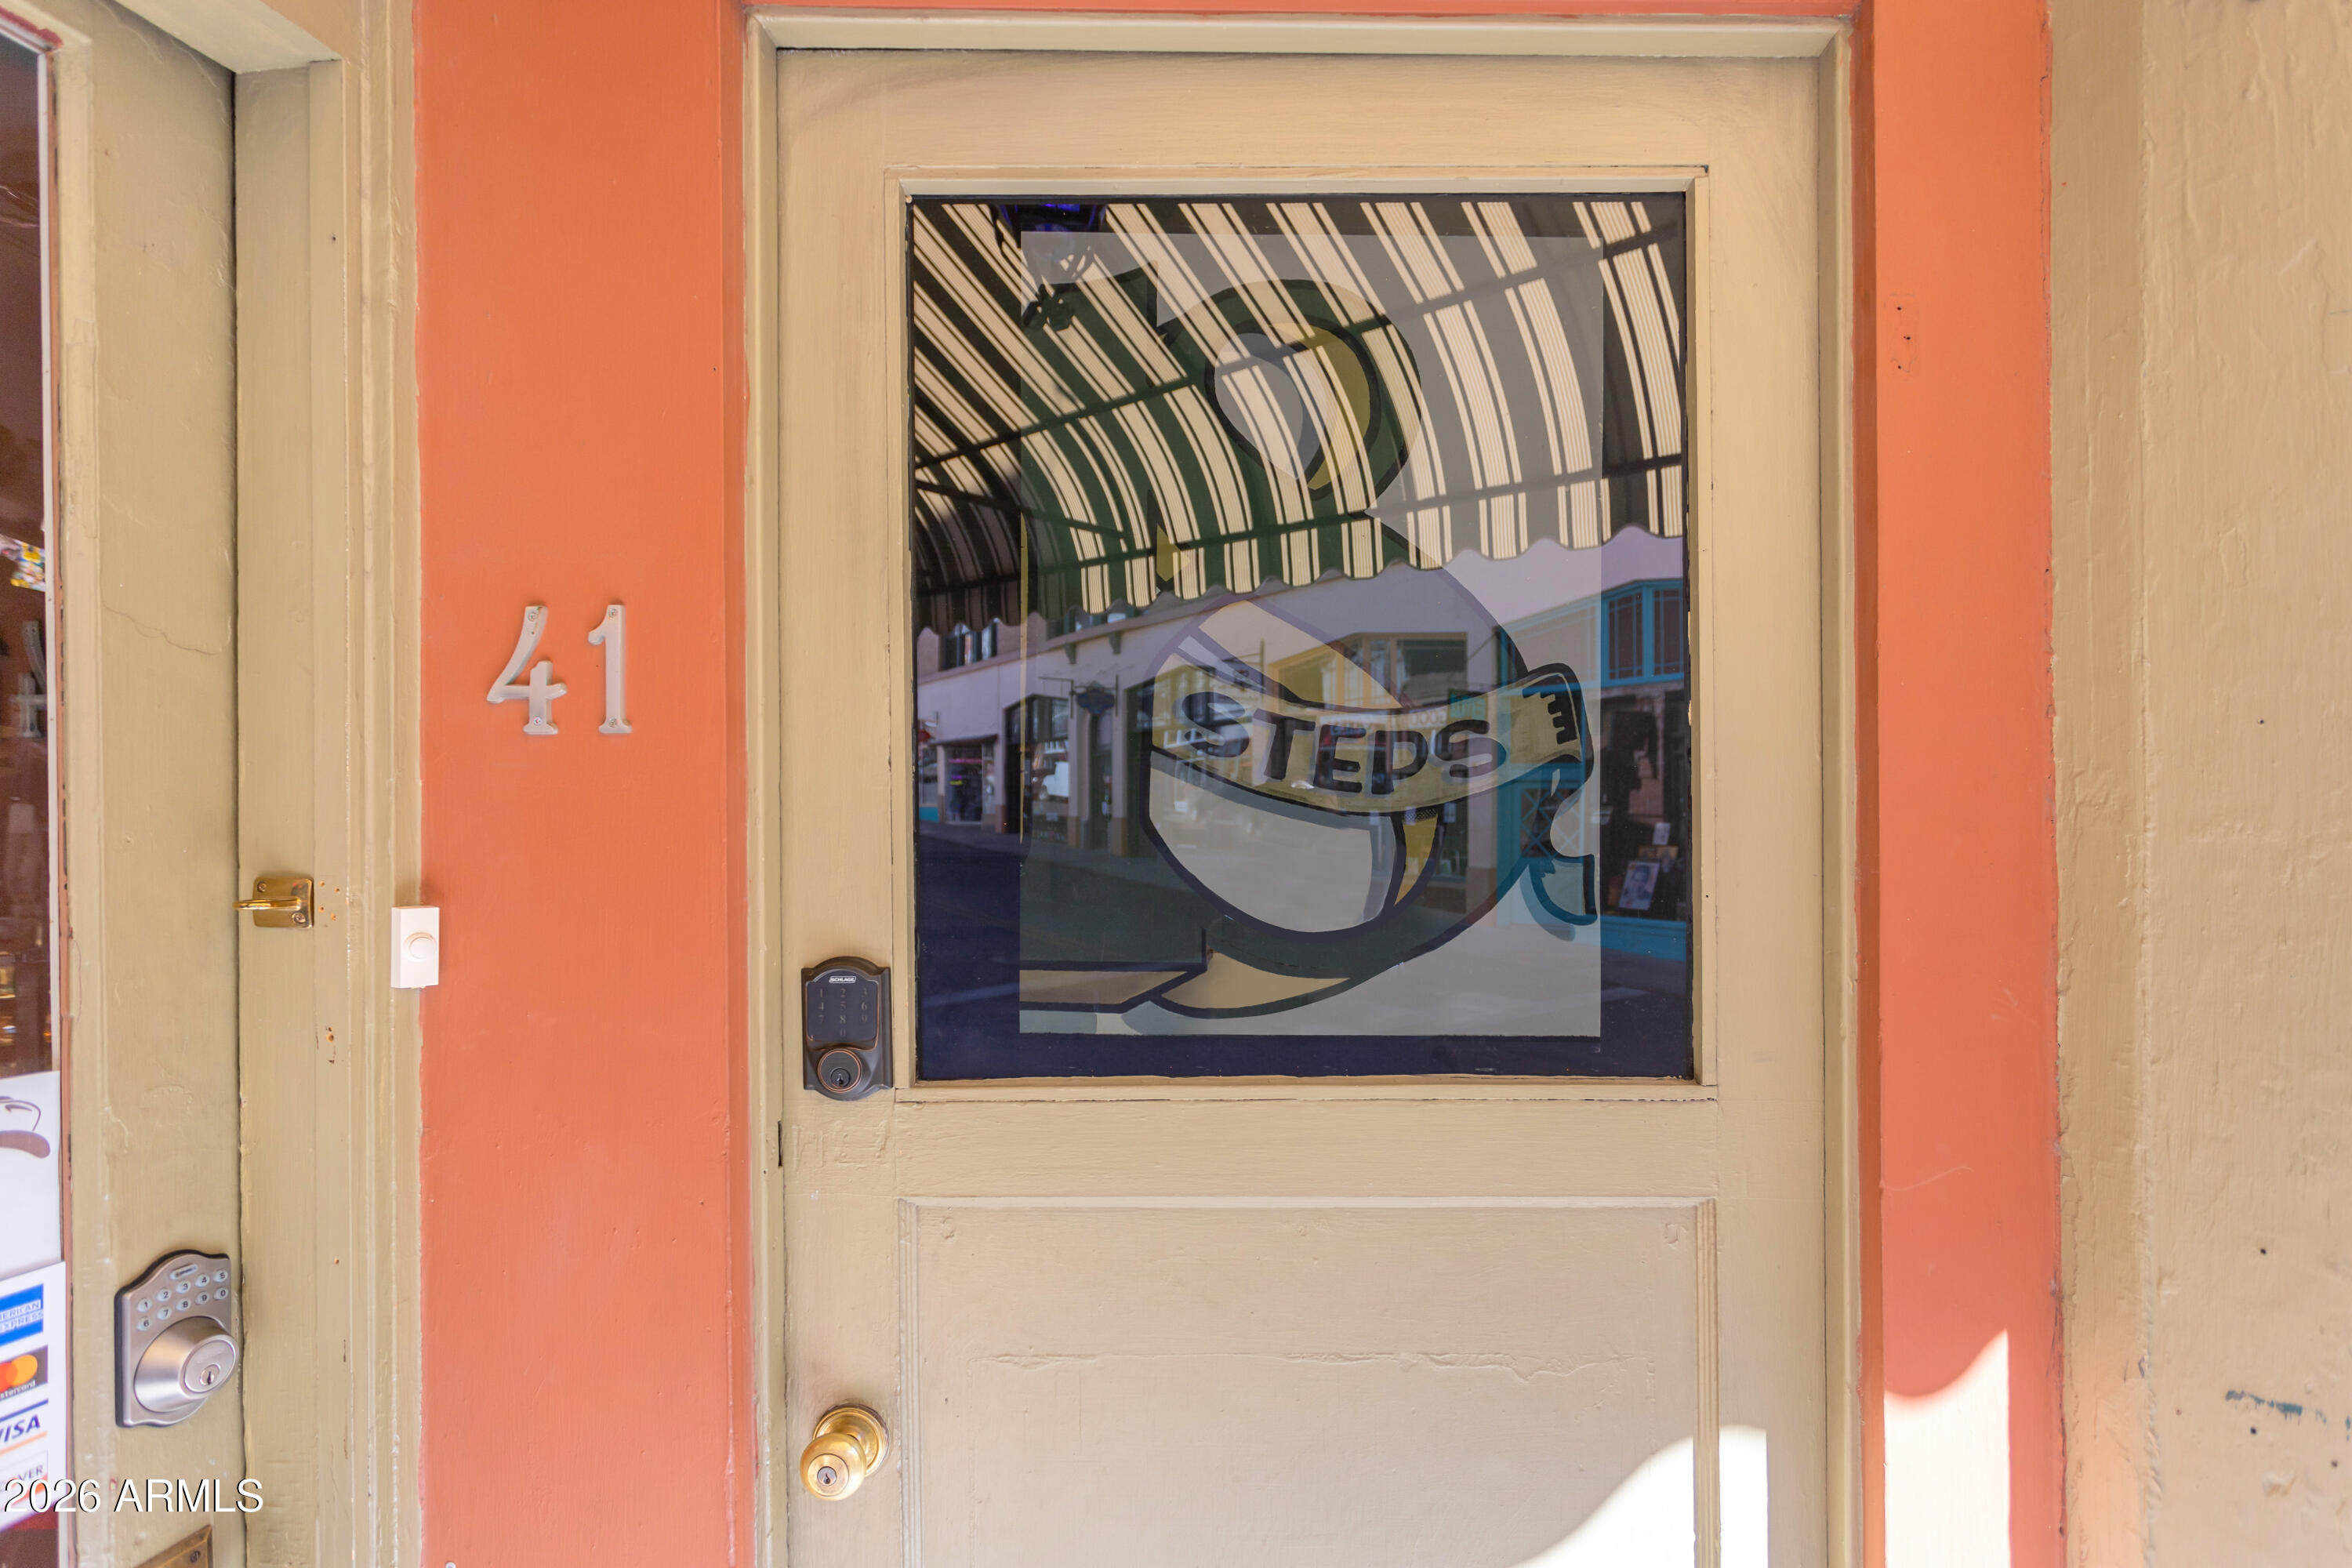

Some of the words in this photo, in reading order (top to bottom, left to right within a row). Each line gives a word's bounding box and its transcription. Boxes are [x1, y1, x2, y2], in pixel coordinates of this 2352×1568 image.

[486, 604, 633, 735] 41
[1180, 691, 1507, 795] STEPS
[0, 1301, 39, 1320] ERICAN
